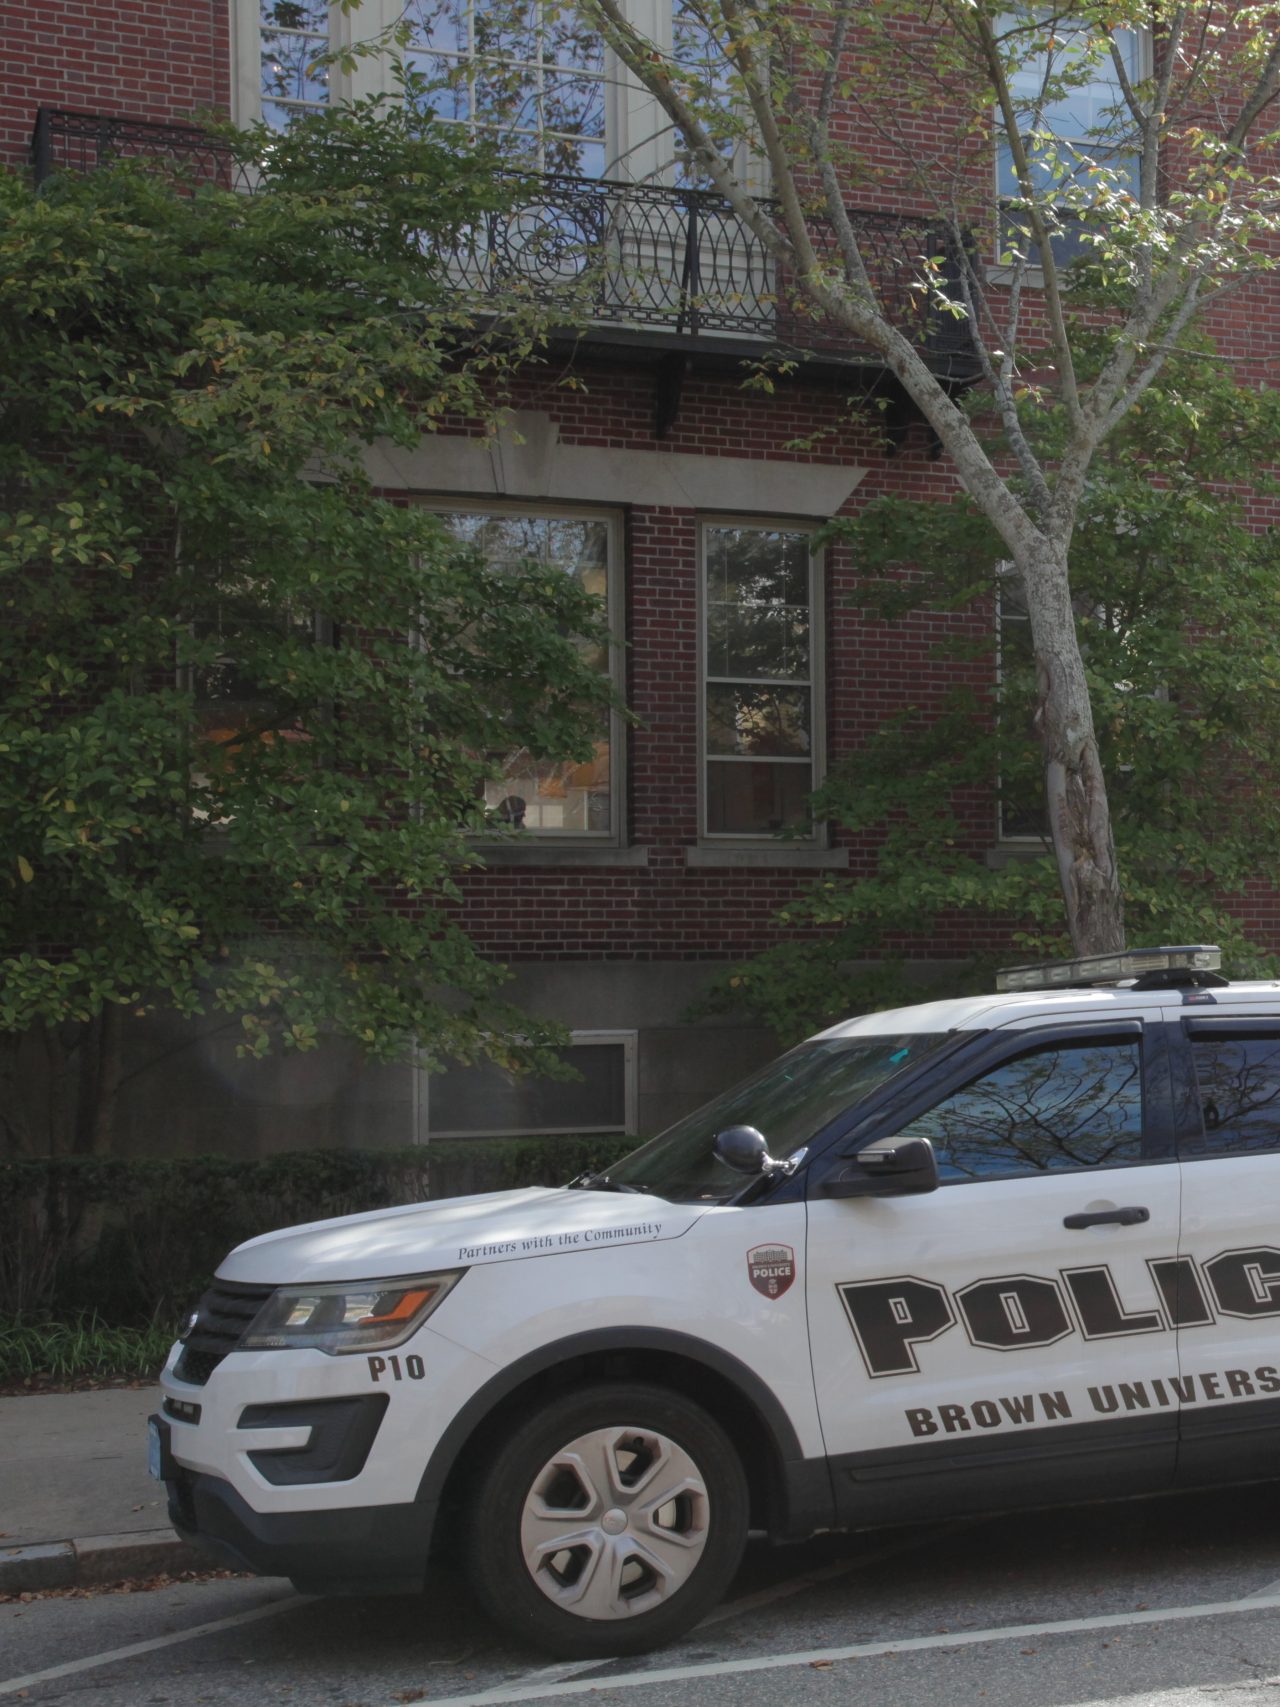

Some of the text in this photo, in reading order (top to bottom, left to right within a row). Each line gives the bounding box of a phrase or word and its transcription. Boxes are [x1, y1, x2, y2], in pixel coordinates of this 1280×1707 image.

[458, 1222, 662, 1260] Partners with the Community
[753, 1266, 791, 1279] POLICE
[367, 1354, 426, 1382] P10
[905, 1390, 1073, 1437] BROWN
